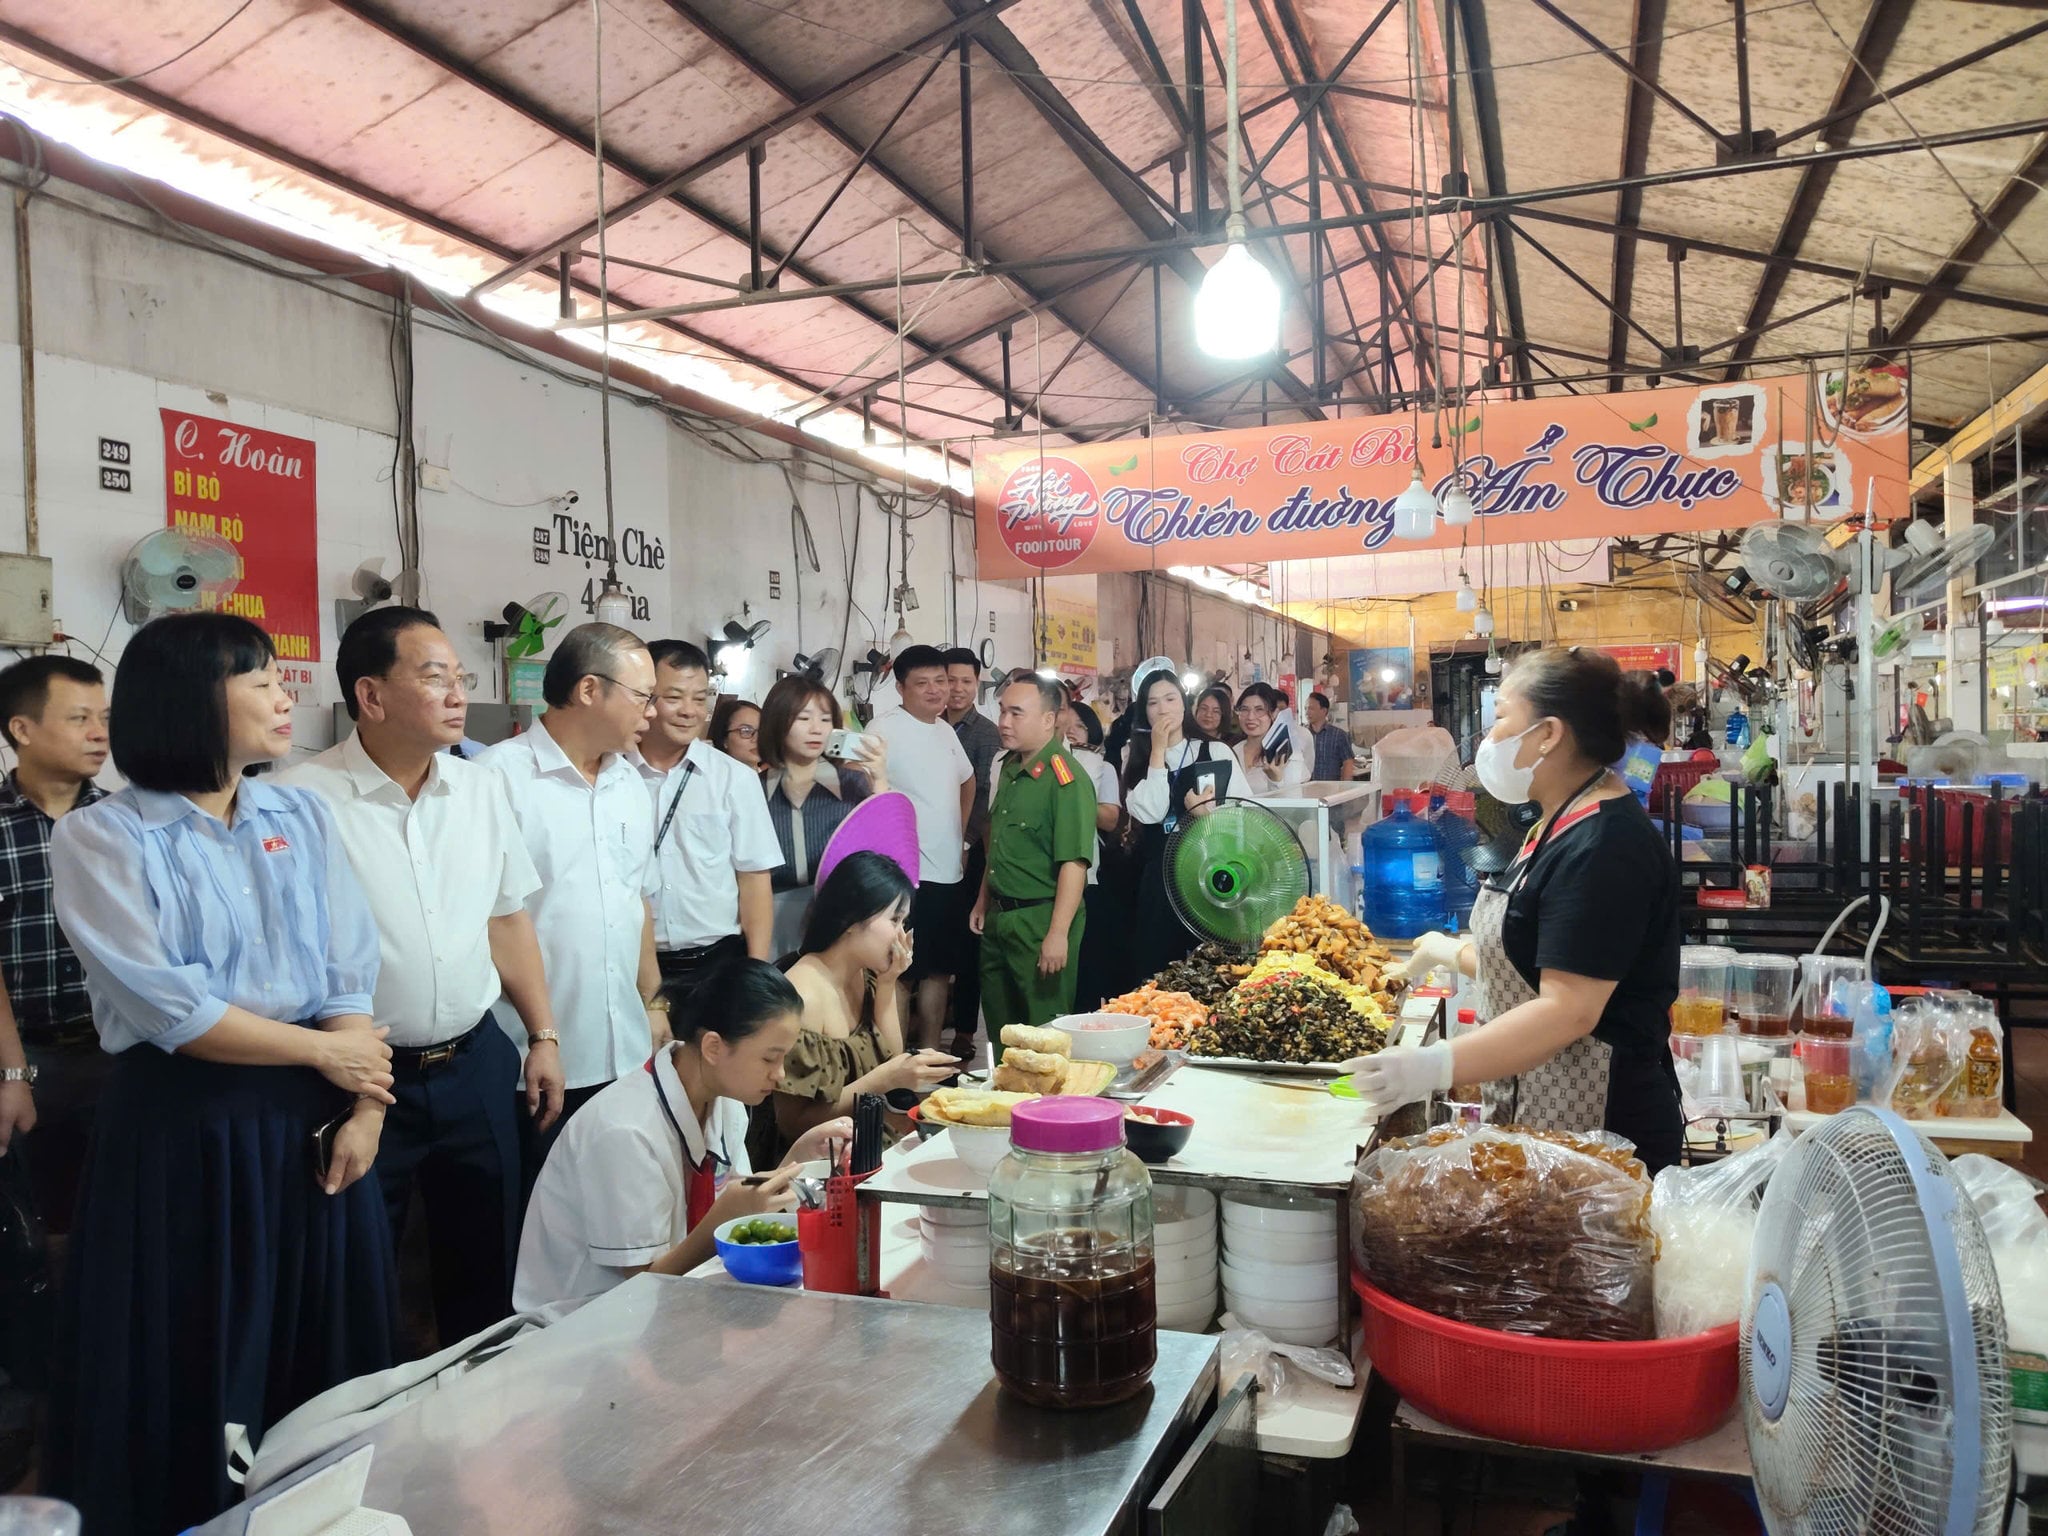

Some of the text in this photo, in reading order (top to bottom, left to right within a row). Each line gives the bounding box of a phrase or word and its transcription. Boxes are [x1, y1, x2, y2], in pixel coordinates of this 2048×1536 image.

[102, 440, 129, 461] 249
[217, 427, 305, 479] Hoàn
[1181, 443, 1259, 485] Chợ
[1268, 434, 1344, 477] Cát
[103, 471, 129, 489] 250
[174, 467, 221, 501] BÌ BÒ
[1101, 423, 1740, 549] Thiên đường Ẩm Thực
[221, 512, 244, 543] BÒ
[553, 513, 665, 571] Tiệm Chè
[222, 592, 266, 619] CHUA
[581, 577, 595, 614] 4
[300, 670, 312, 684] BI
